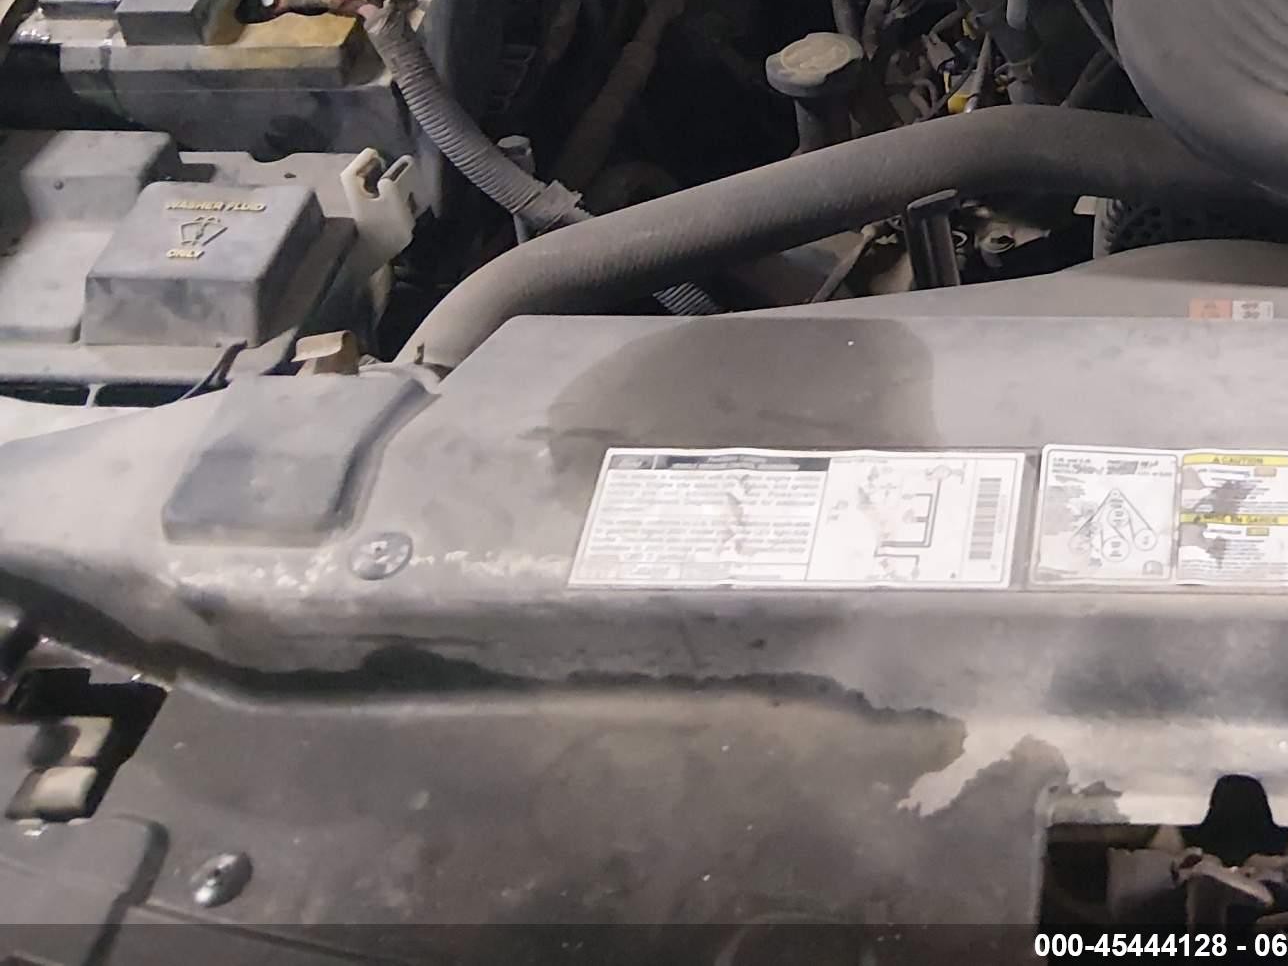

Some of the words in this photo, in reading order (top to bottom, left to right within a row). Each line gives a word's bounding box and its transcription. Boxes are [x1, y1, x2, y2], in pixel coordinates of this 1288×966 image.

[166, 201, 223, 211] WASHER
[226, 201, 267, 212] FLUID
[166, 248, 205, 260] ONLY
